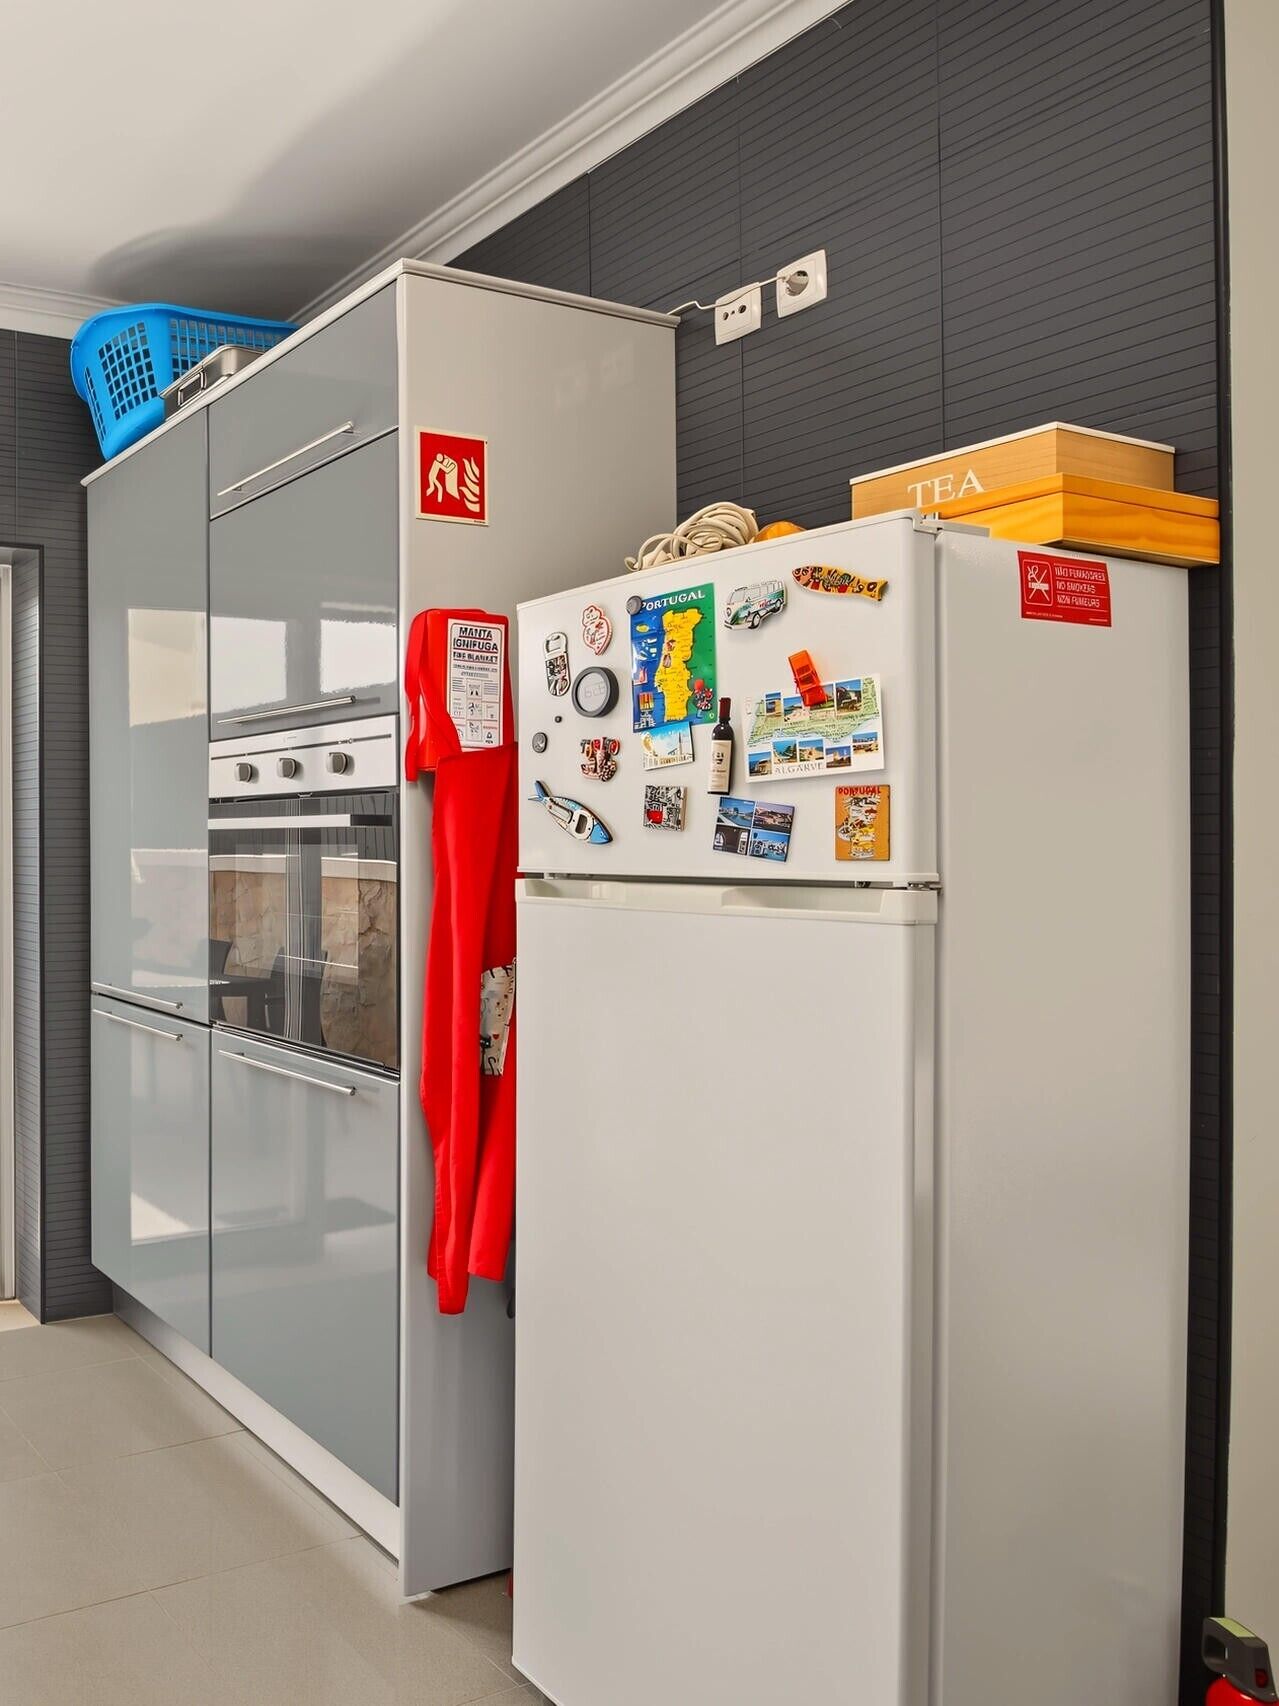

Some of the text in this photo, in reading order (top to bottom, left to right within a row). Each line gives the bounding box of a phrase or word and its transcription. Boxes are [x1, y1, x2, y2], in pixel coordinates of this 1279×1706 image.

[907, 469, 984, 508] TEA
[459, 627, 493, 639] MANTA
[453, 637, 498, 651] IGNIFUGA
[775, 762, 824, 774] ALGARVE
[838, 786, 881, 796] PORTUGAL
